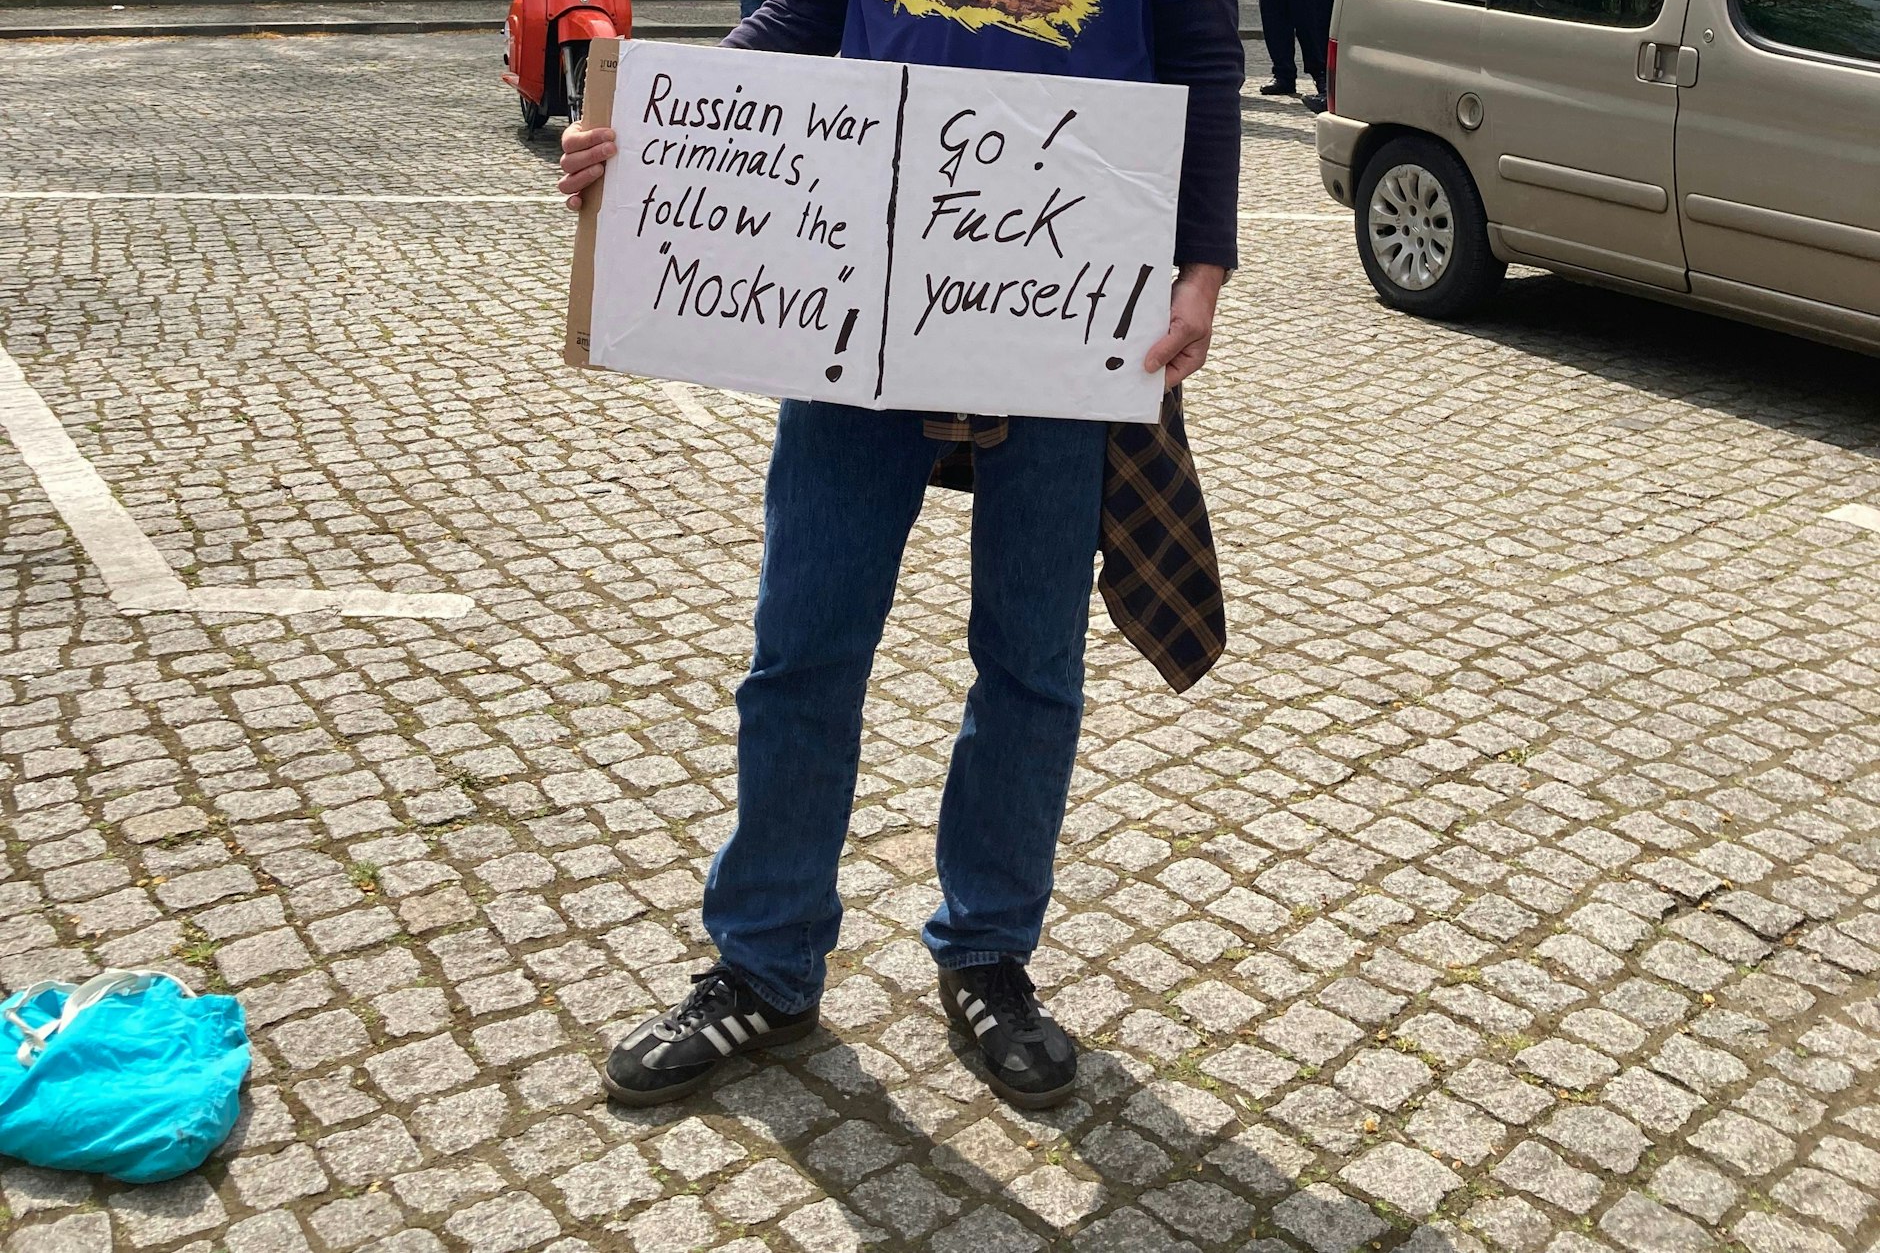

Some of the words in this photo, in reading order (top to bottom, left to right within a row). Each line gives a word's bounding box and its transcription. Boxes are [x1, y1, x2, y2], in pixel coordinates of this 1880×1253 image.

[643, 73, 783, 137] Russian
[641, 135, 820, 194] criminals,
[636, 184, 772, 238] follow
[796, 201, 847, 250] the
